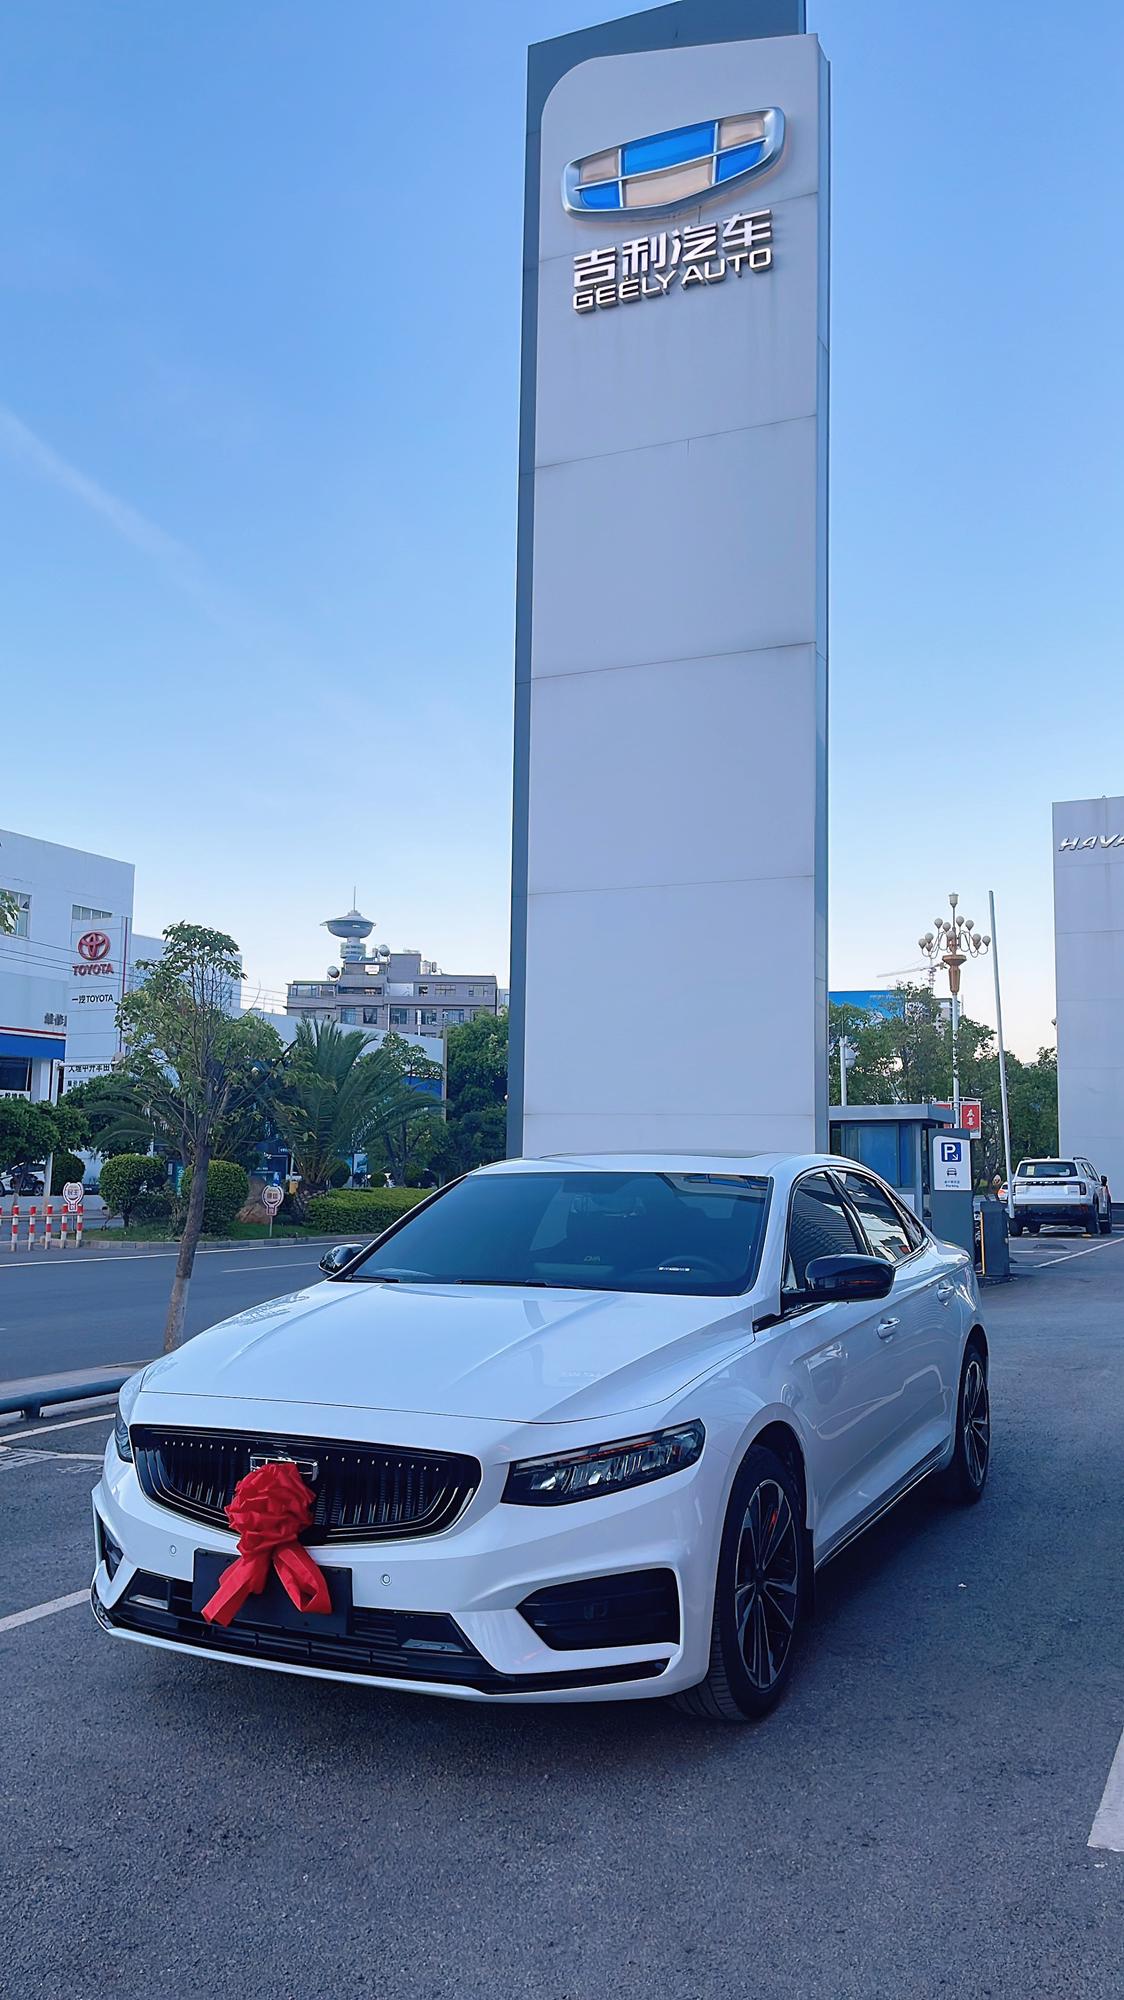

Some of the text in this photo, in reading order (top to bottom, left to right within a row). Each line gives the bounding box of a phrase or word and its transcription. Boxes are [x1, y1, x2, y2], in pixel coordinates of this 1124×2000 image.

[573, 208, 772, 289] 吉利汽车
[573, 247, 773, 314] GEELY AUTO
[72, 963, 114, 976] TOYOTA
[944, 1143, 956, 1160] P
